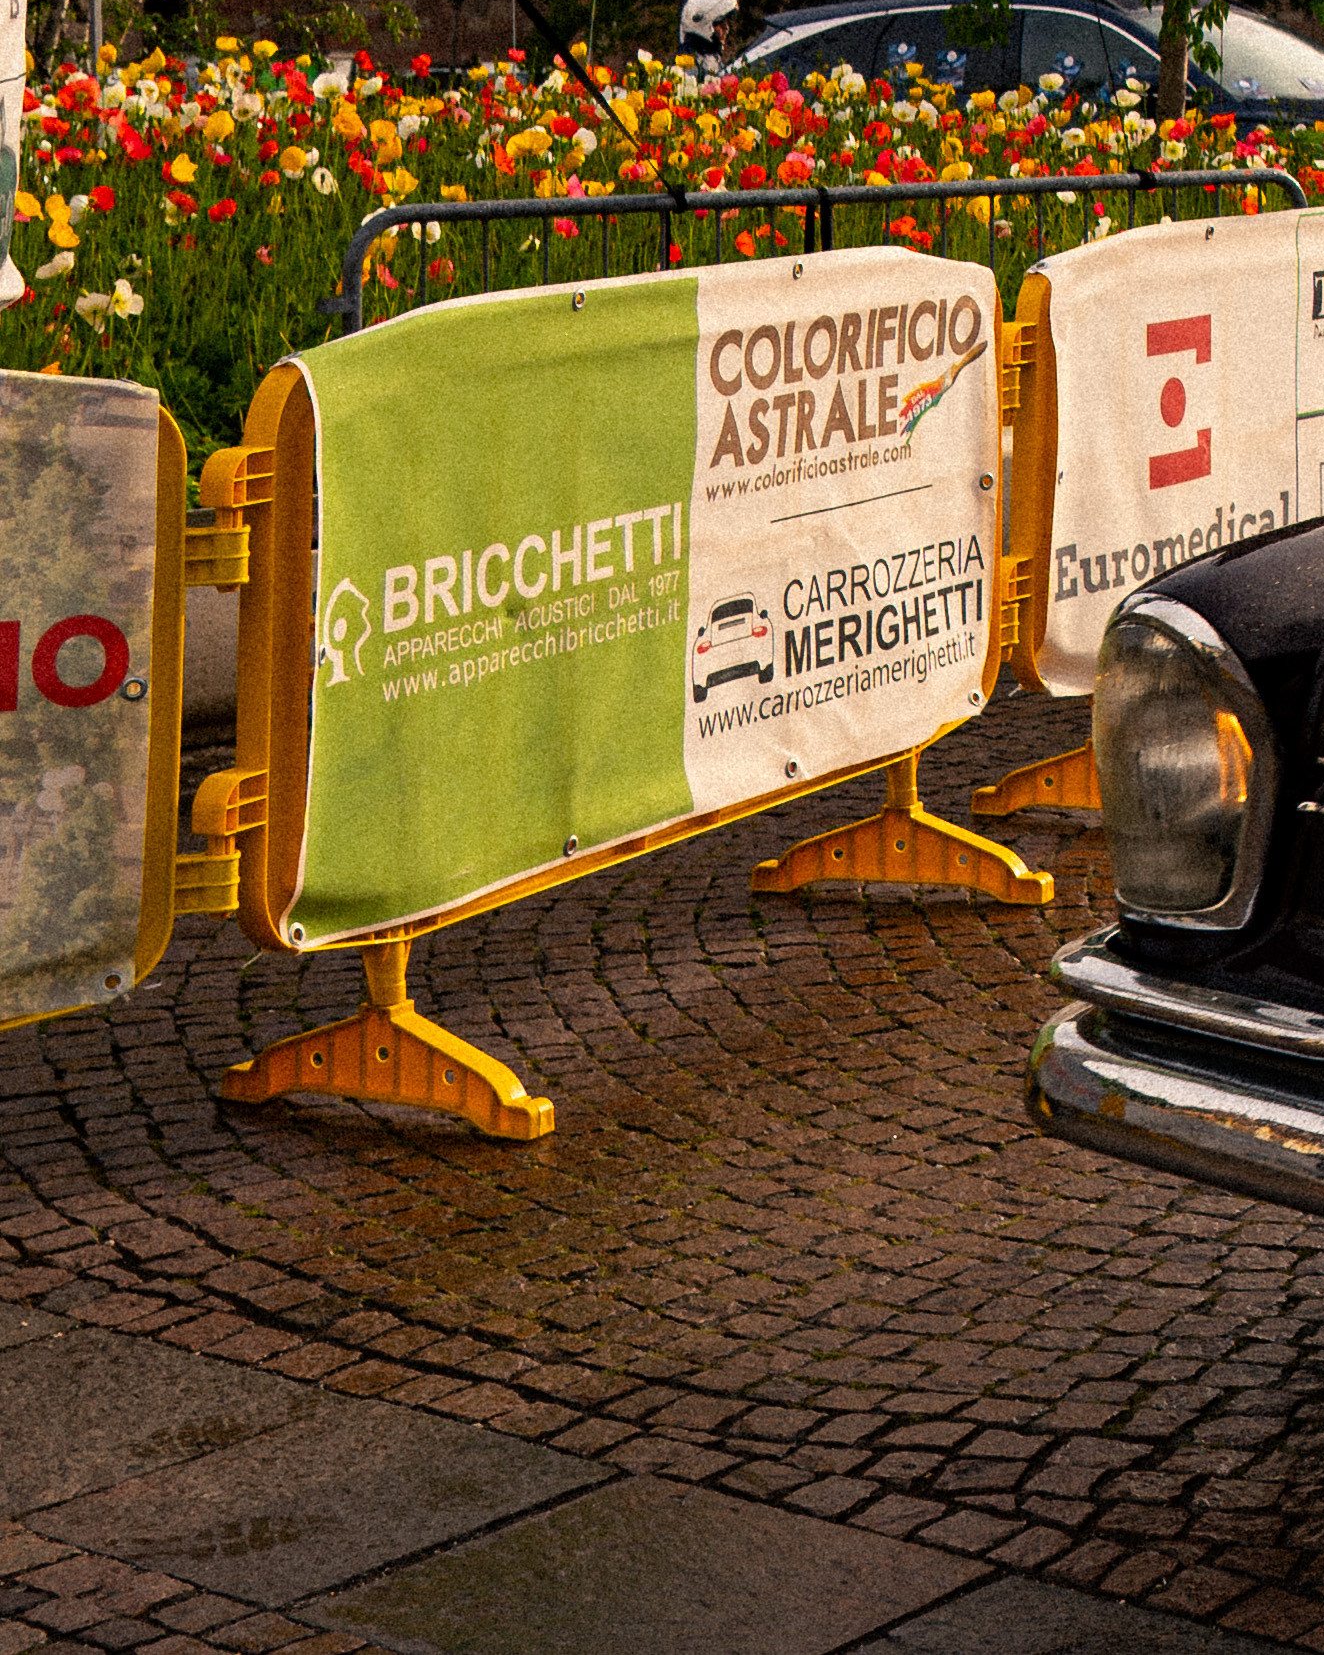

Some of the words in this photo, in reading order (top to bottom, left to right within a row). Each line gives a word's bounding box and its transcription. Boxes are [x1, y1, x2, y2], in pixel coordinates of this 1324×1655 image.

[709, 295, 981, 396] COLORIFICIO
[709, 375, 899, 469] ASTRALE
[705, 444, 911, 502] www.colorificioastrale.com
[383, 502, 684, 634] BRICCHETTI
[782, 535, 983, 620] CARROZZERIA
[1055, 492, 1292, 601] Euromedical
[381, 599, 682, 701] www.apparecchibricchetti.it
[383, 618, 504, 668] APPARECCHI
[514, 597, 597, 644] ACUSTICI
[609, 585, 639, 623] DAL
[648, 571, 680, 601] 1977
[784, 579, 981, 677] MERIGHETTI
[699, 632, 976, 739] www.carrozzeriamerighetti.it
